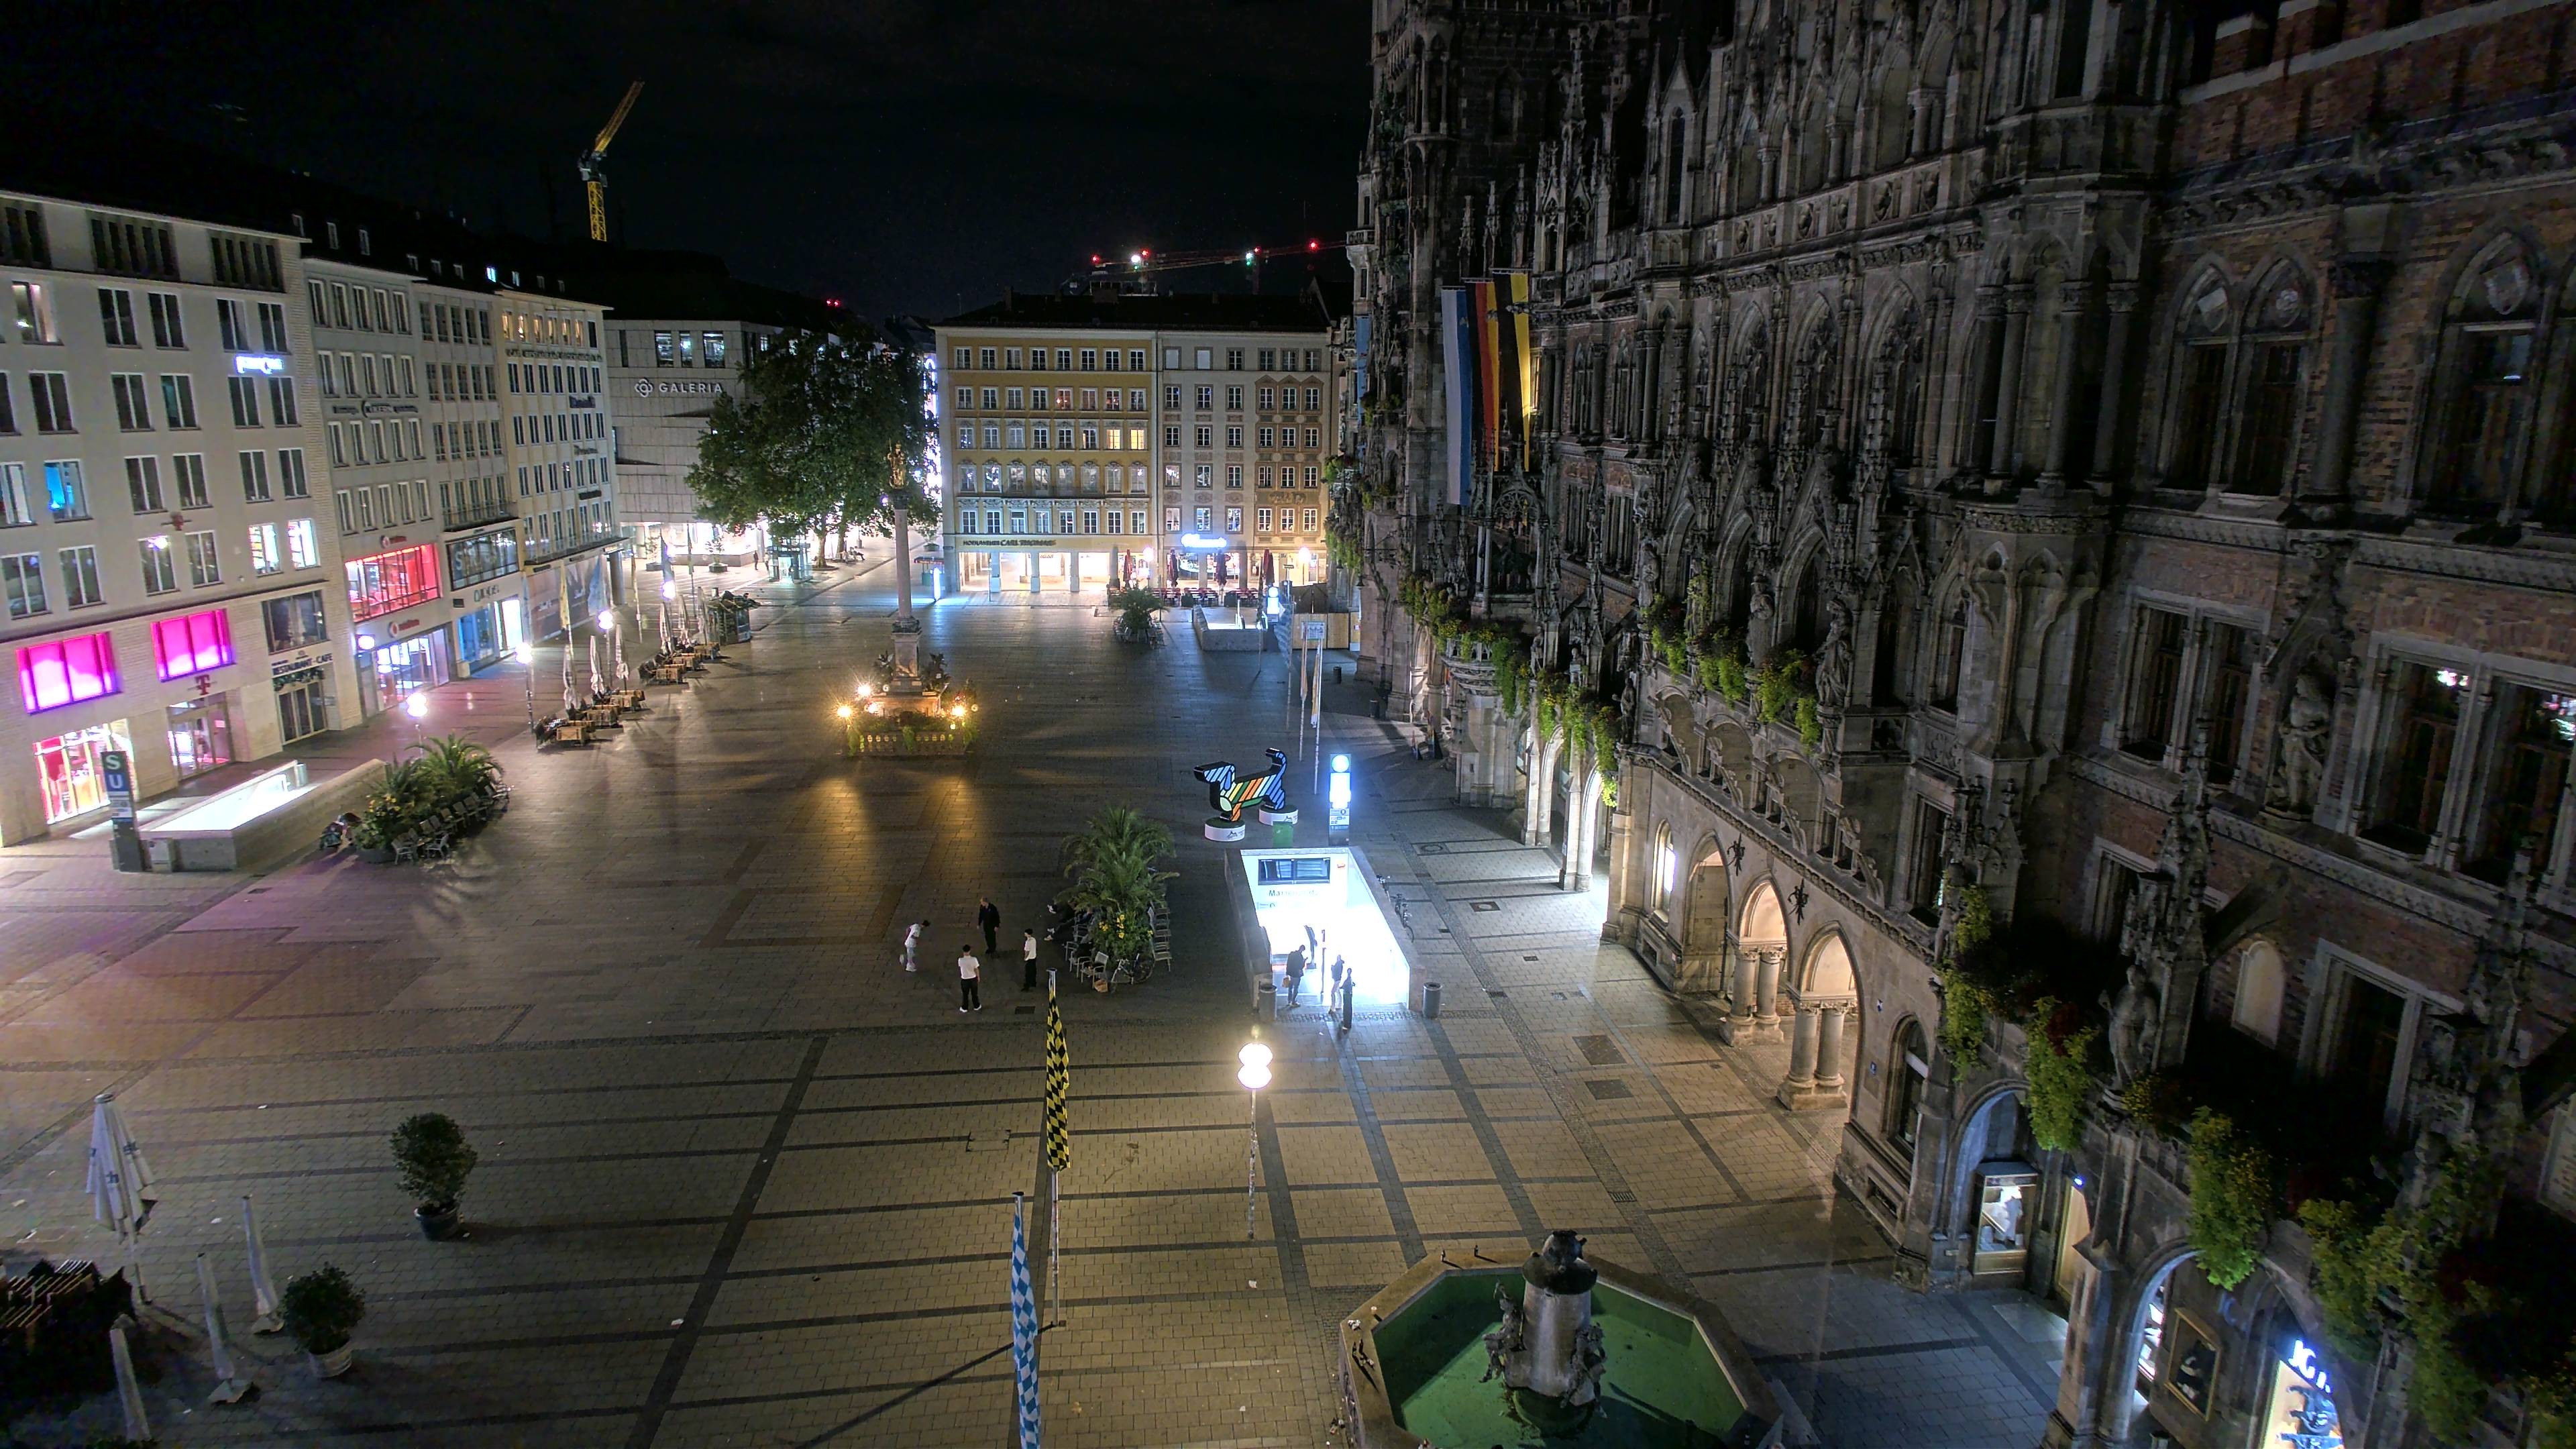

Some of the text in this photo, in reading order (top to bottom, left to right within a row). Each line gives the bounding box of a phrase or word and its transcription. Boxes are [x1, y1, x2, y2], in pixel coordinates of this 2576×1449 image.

[659, 383, 722, 393] GALERIA
[105, 754, 121, 770] S
[108, 773, 123, 789] U
